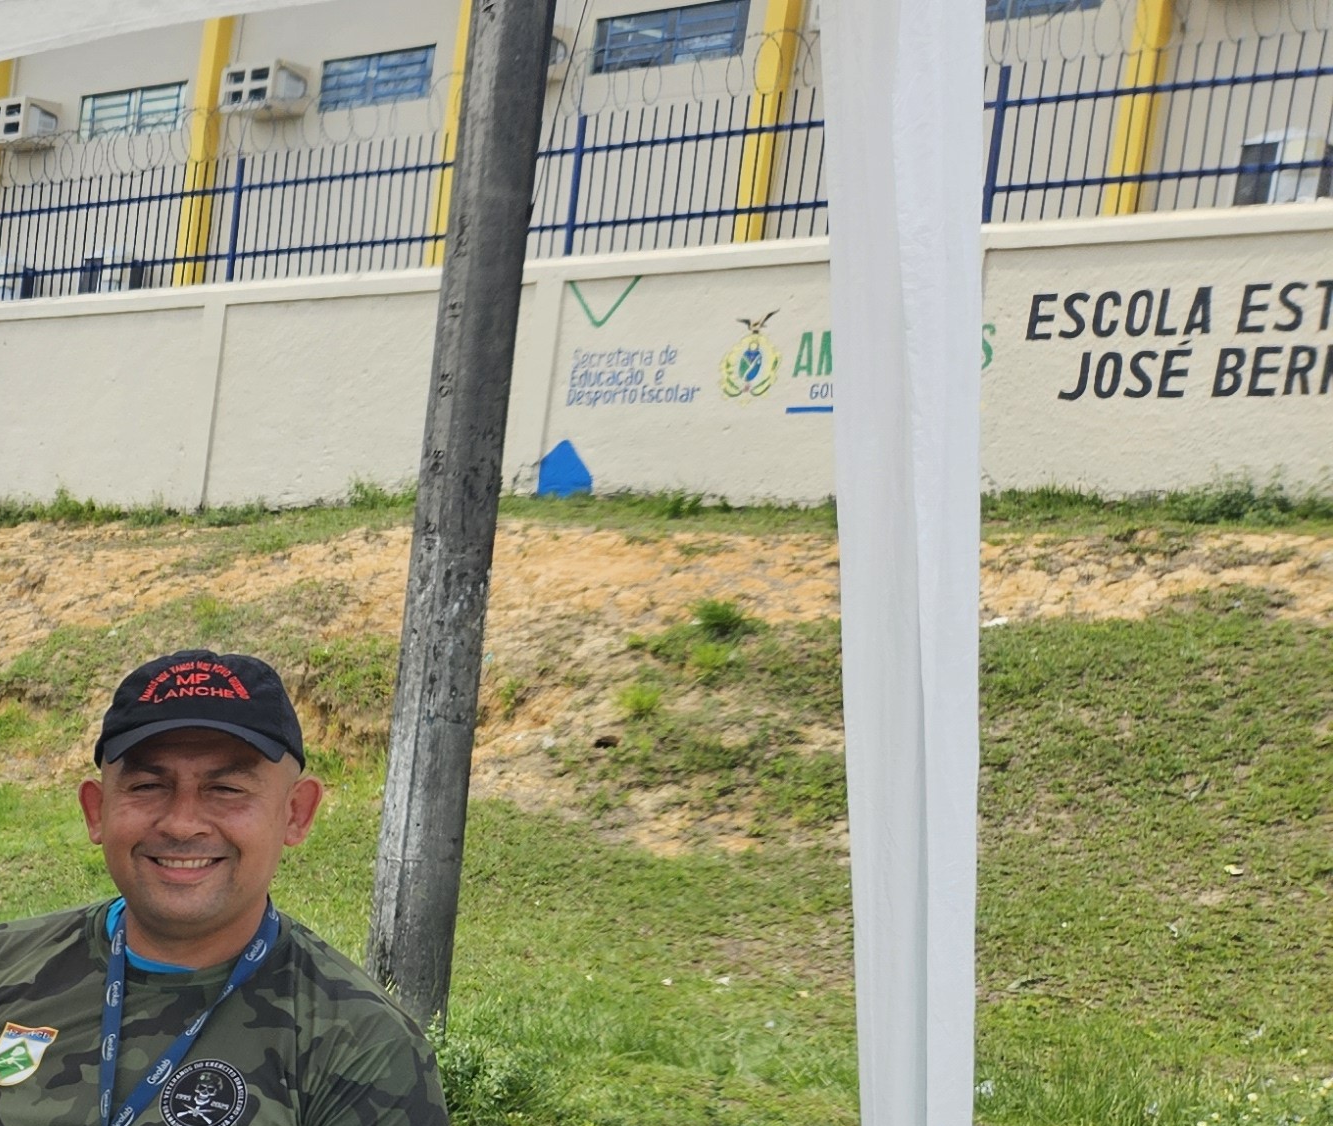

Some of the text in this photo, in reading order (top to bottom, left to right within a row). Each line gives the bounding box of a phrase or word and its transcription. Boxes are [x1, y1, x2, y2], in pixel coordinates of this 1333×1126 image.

[1026, 286, 1212, 341] ESCOLA
[573, 344, 678, 369] Secretaria de
[654, 368, 665, 385] e
[1057, 340, 1192, 401] JOSÉ
[565, 383, 701, 409] Desporto Escolar
[176, 673, 210, 686] MP
[154, 686, 235, 703] LANCHE
[245, 938, 265, 961] Geolab
[147, 1058, 171, 1085] Geolab
[163, 1065, 193, 1099] VETERANOS
